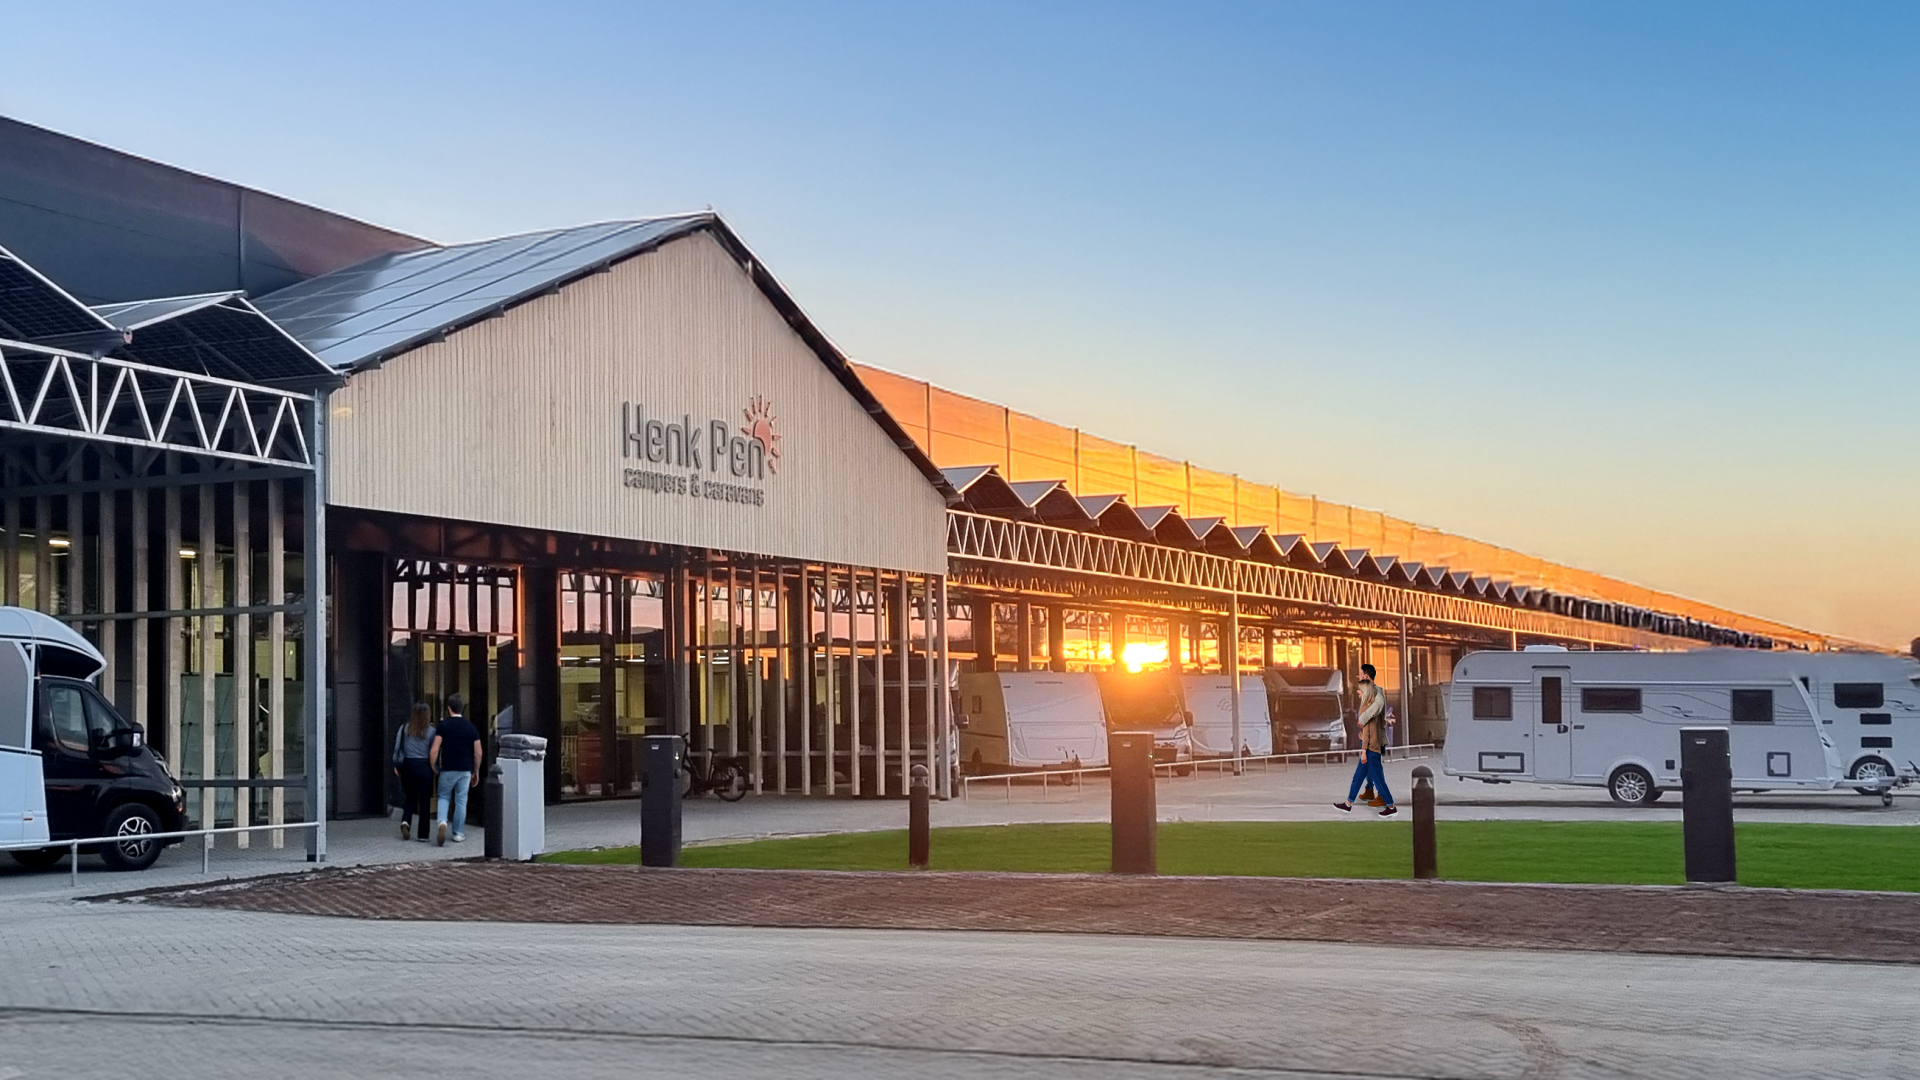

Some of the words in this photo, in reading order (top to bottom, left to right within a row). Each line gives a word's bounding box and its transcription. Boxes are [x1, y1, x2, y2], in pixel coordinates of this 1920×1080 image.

[623, 401, 702, 469] Henk
[711, 420, 764, 480] Pen
[624, 468, 687, 495] campers
[690, 474, 701, 497] &
[704, 481, 764, 507] caravans
